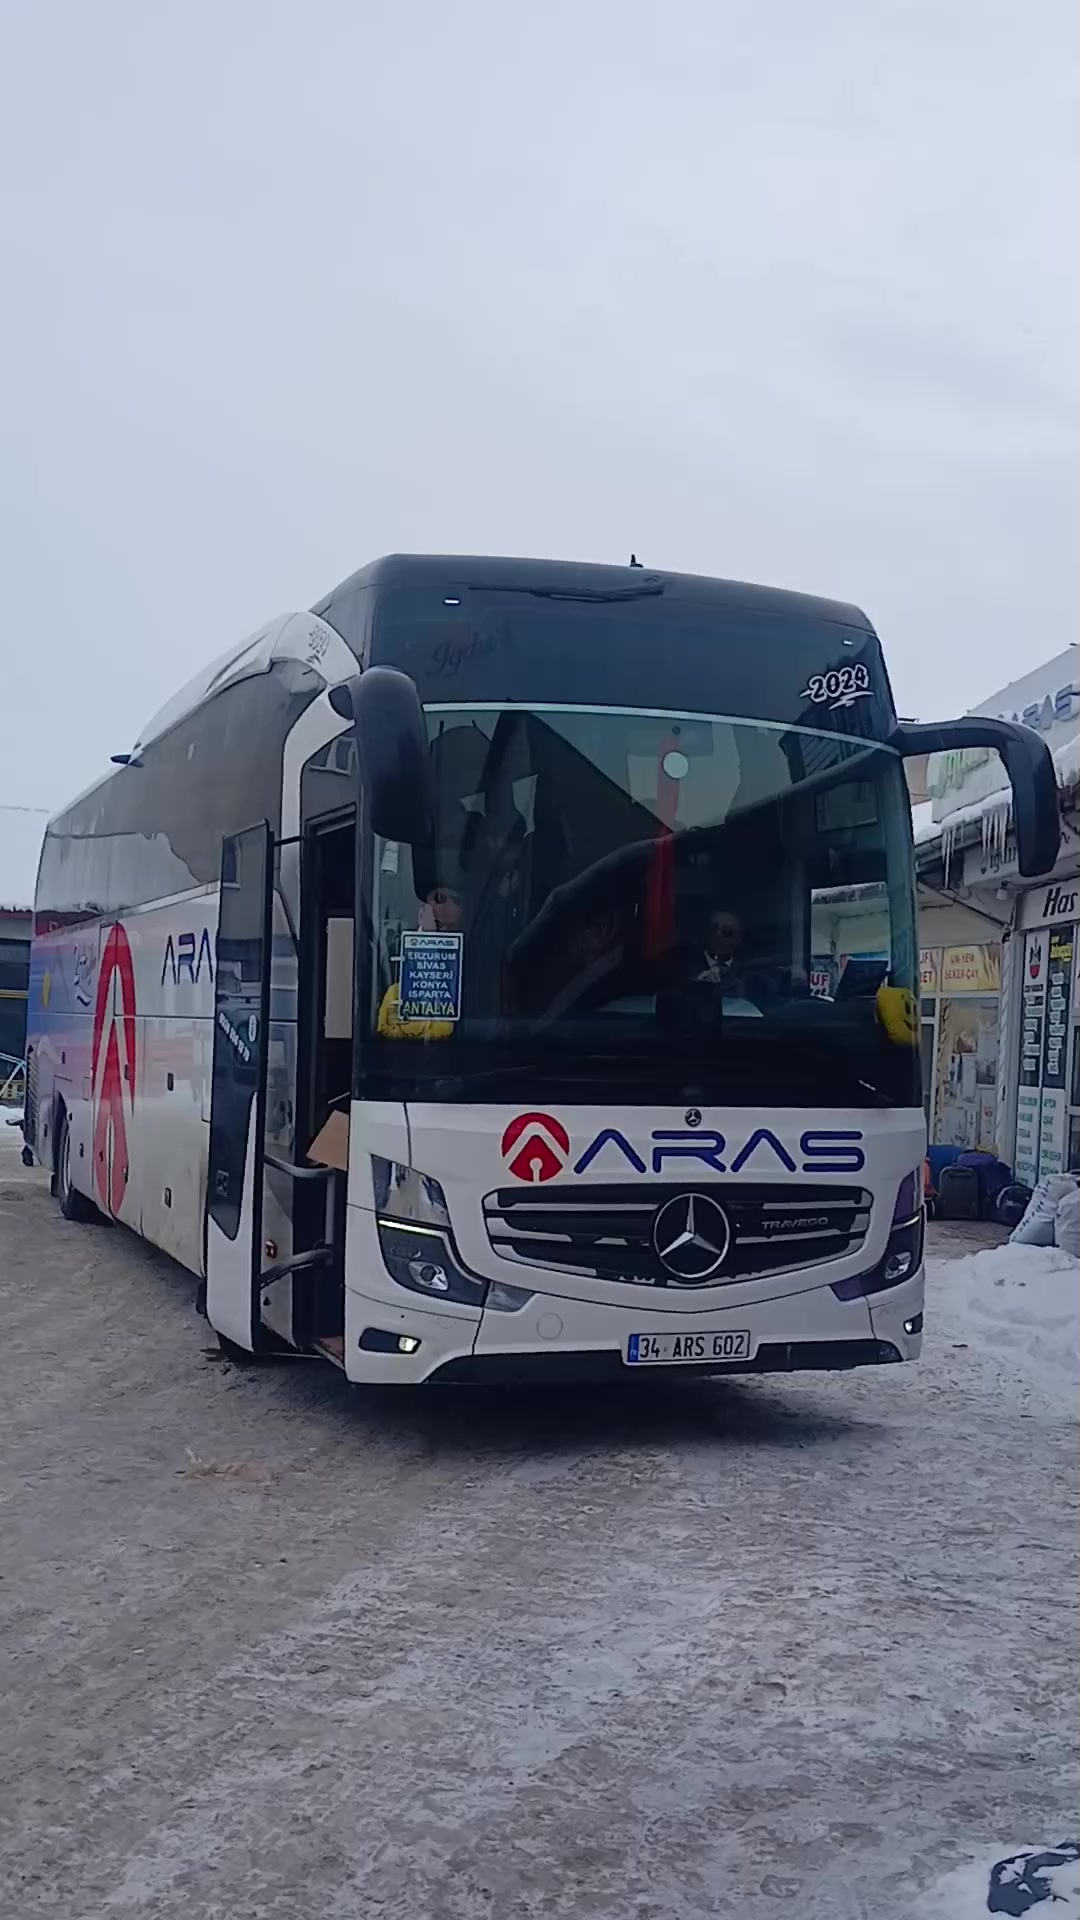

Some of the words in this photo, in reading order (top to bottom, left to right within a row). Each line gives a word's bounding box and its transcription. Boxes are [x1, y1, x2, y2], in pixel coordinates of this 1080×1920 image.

[808, 663, 869, 703] 2024
[1012, 683, 1074, 731] RAS
[1043, 887, 1078, 918] Has
[160, 927, 215, 986] ARA
[407, 952, 457, 960] ERZURUM
[416, 961, 446, 970] SİVAS
[409, 970, 454, 980] KAYSERİ
[412, 980, 448, 989] KONYA
[408, 990, 452, 998] ISPARTA
[403, 1001, 455, 1016] ANTALYA
[573, 1128, 865, 1174] ARAS
[761, 1217, 829, 1230] TRAVEGO
[640, 1338, 660, 1358] 34
[672, 1336, 705, 1357] ARS
[712, 1335, 745, 1355] 602
